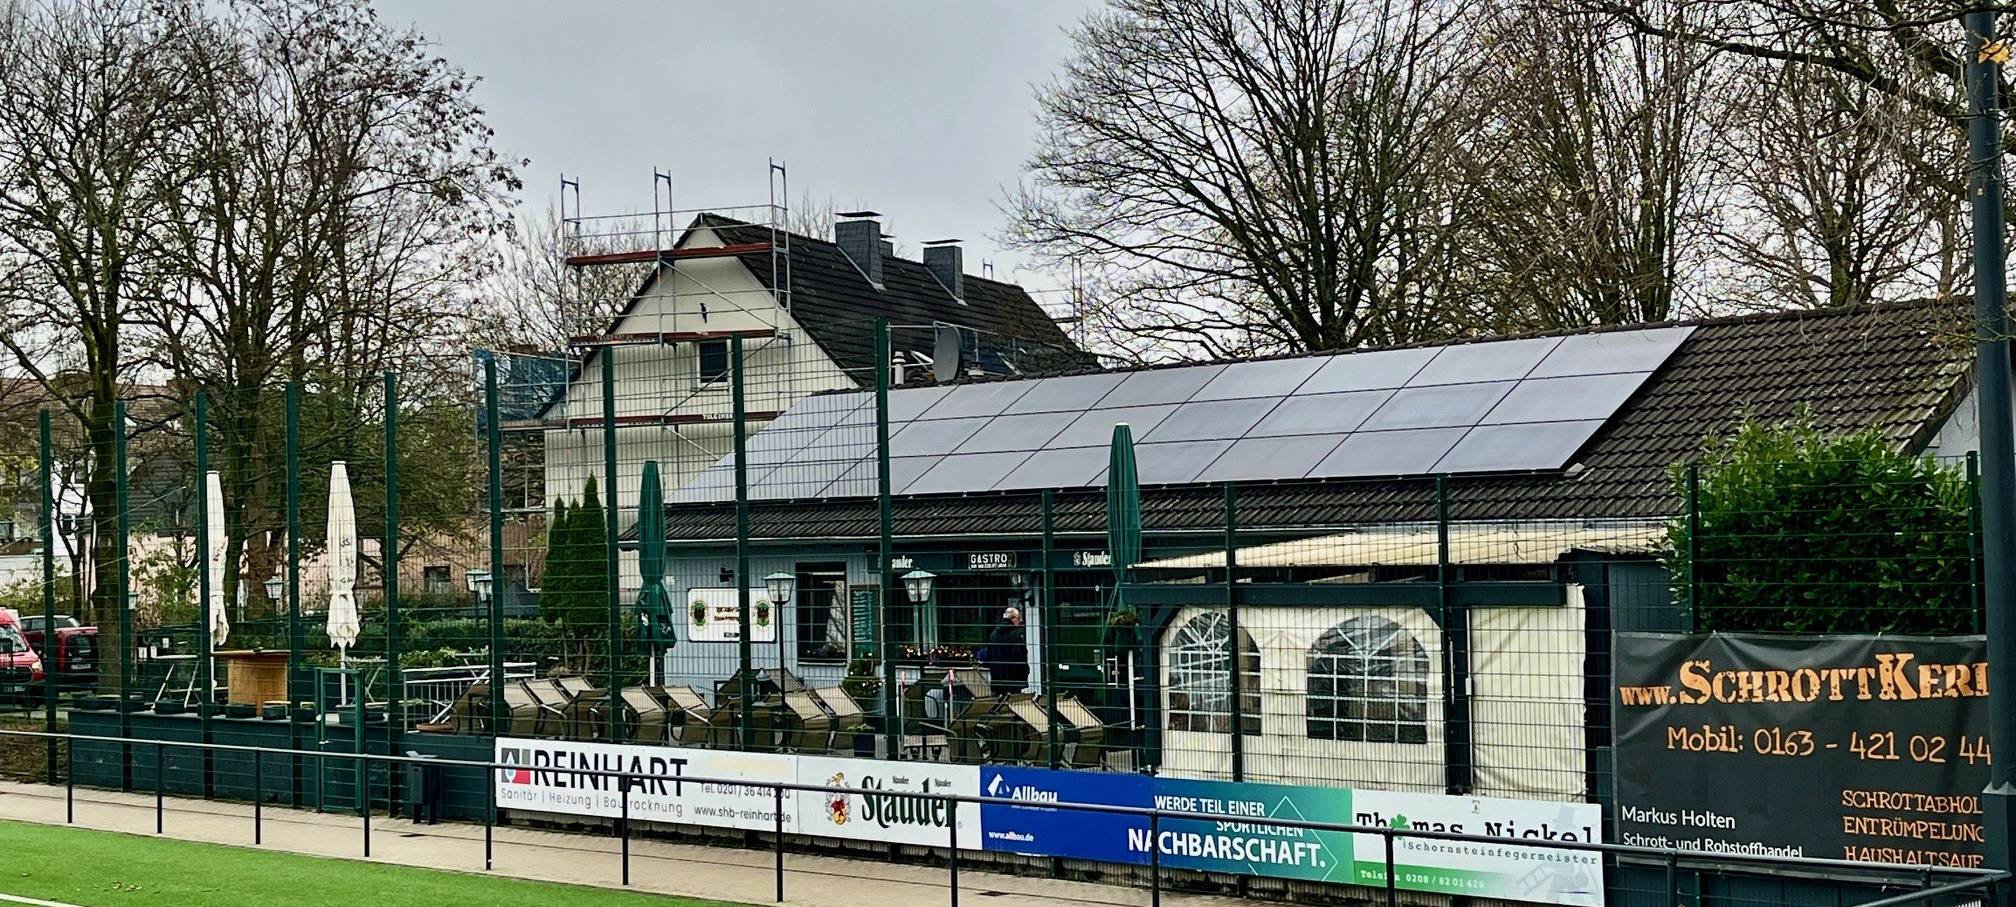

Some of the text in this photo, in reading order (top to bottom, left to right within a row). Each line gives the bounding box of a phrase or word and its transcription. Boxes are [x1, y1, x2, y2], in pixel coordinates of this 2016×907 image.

[970, 553, 1008, 564] GASTRO
[1666, 725, 1743, 754] Mobil:
[1753, 727, 1815, 757] 0163
[1849, 732, 1900, 761] 421
[1909, 736, 1946, 764] 02
[1959, 735, 1992, 766] 44
[534, 749, 687, 797] REINHART
[550, 793, 591, 809] Heizung
[604, 795, 683, 817] Baurocknung
[1011, 785, 1058, 803] Allbau
[1842, 789, 1984, 814] SCHROTTABHOL
[694, 805, 792, 823] www.shb-reinhartde
[1154, 795, 1266, 817] WERDE TEIL EINER
[1621, 805, 1736, 830] Markus Holten
[1216, 820, 1304, 838] SPORTLICHEN
[1623, 832, 1803, 859] Schrott- und Rohstoffhandel
[1360, 869, 1400, 882] Telefn
[1405, 873, 1429, 884] 0208
